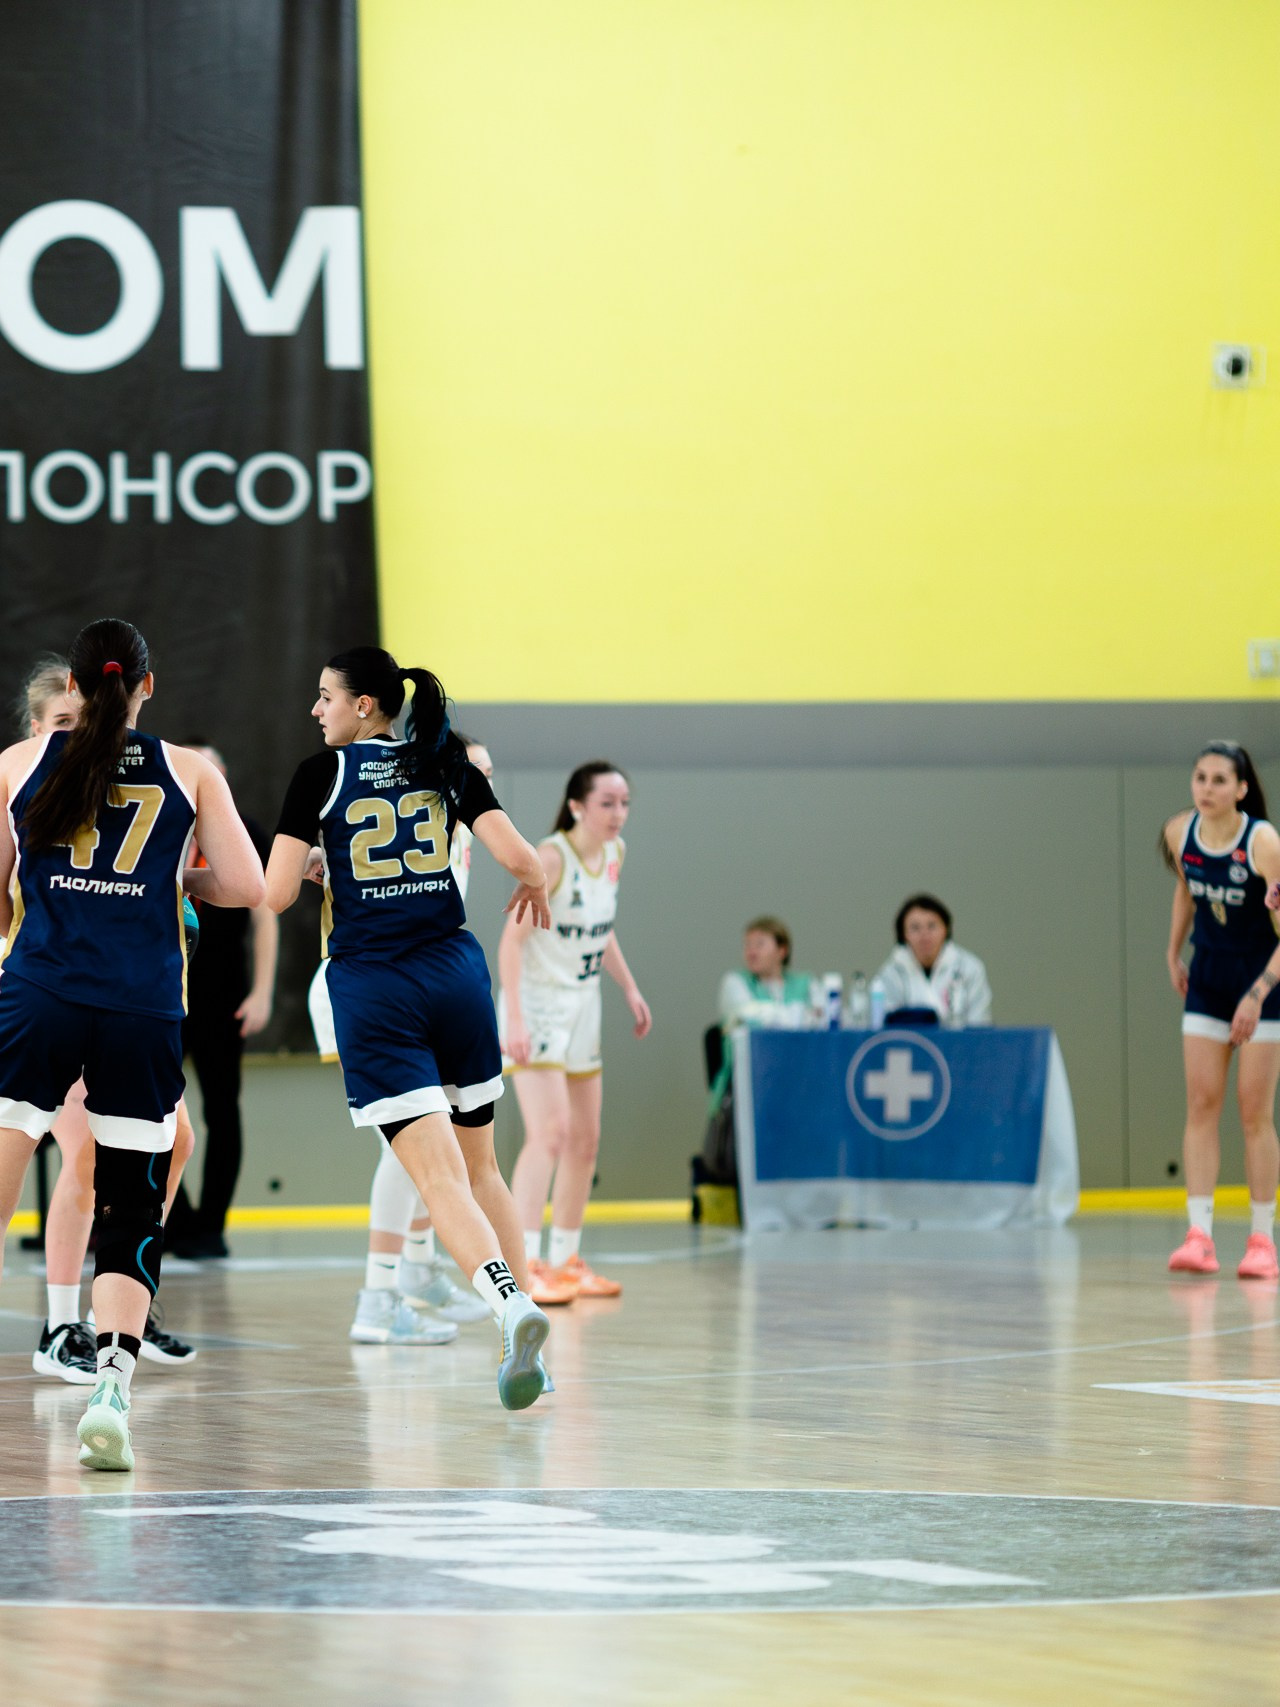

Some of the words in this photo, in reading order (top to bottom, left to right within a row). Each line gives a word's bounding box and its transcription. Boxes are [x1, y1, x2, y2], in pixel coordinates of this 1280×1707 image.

[51, 783, 166, 875] 47
[345, 789, 450, 881] 23
[49, 874, 147, 897] ГЦОЛИФК
[361, 879, 451, 900] ГЦОЛИФК
